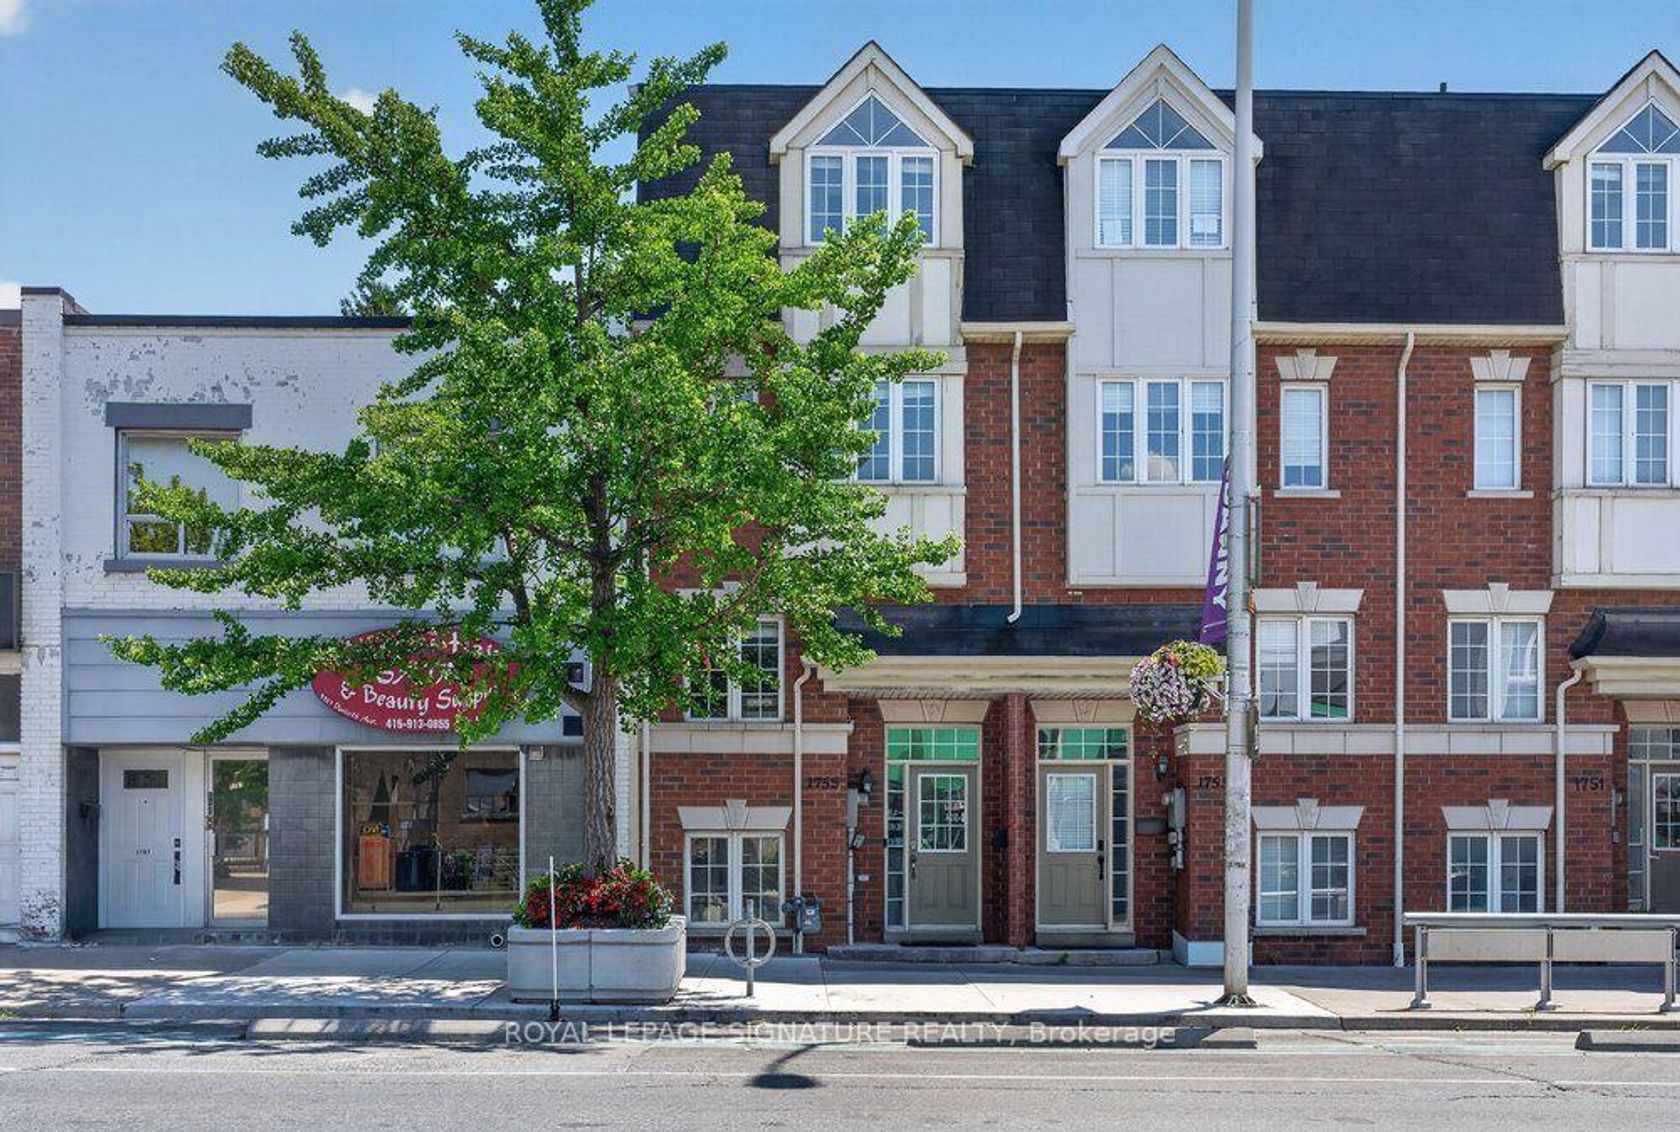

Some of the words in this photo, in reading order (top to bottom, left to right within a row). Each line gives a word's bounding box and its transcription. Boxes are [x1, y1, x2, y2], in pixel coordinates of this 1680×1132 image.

[341, 681, 356, 699] &
[808, 776, 839, 790] 1755
[1199, 776, 1226, 790] 175
[1575, 776, 1604, 791] 1751
